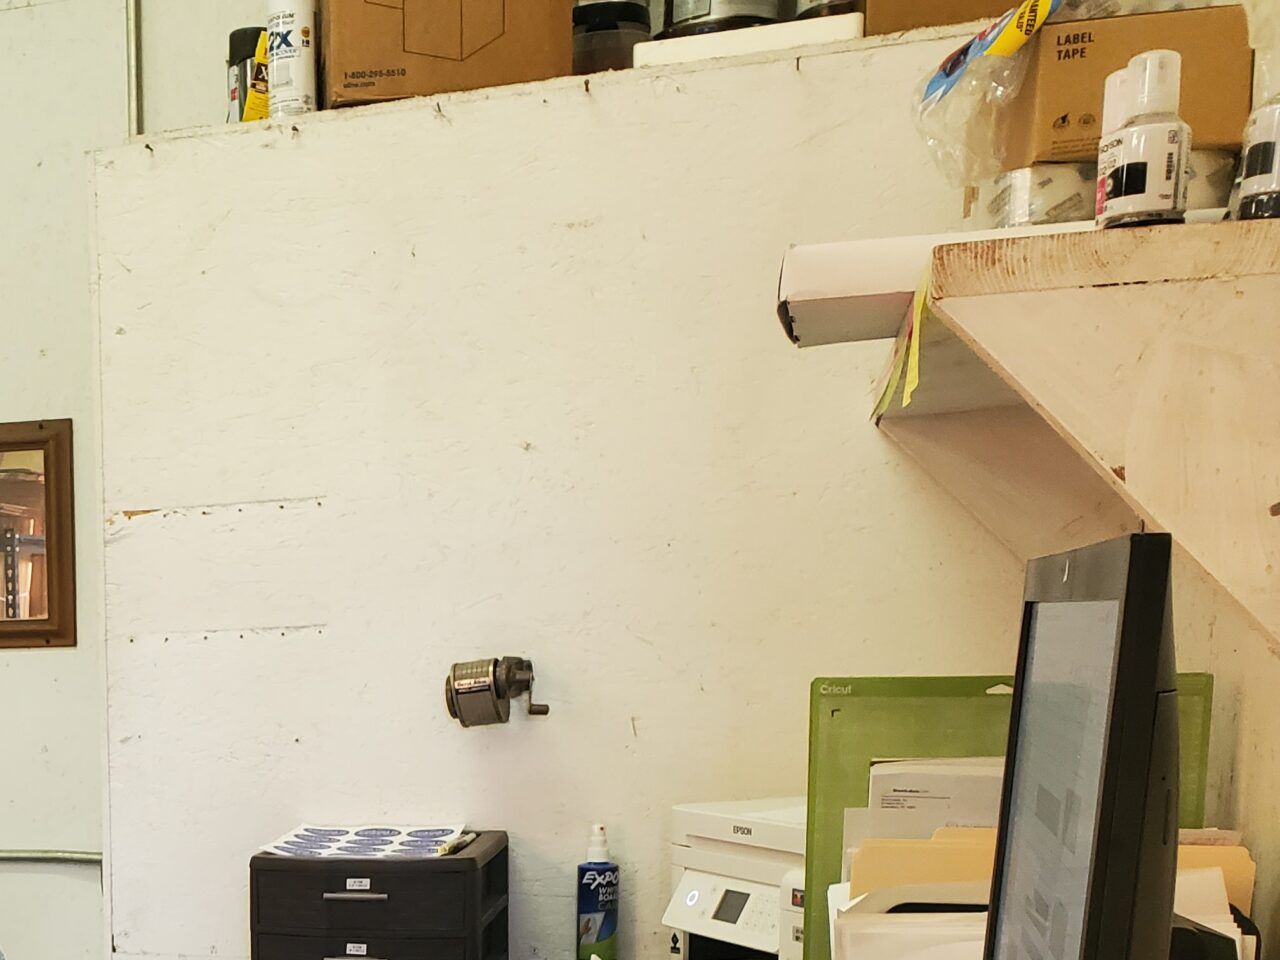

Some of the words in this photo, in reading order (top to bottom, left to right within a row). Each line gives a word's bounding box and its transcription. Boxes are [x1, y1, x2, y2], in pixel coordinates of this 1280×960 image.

[1056, 32, 1095, 46] LABEL
[1057, 48, 1086, 61] TAPE
[344, 68, 407, 80] 1-800-295-5510
[820, 683, 852, 695] Cricut
[732, 825, 753, 837] EPSON
[582, 870, 619, 890] EXPO
